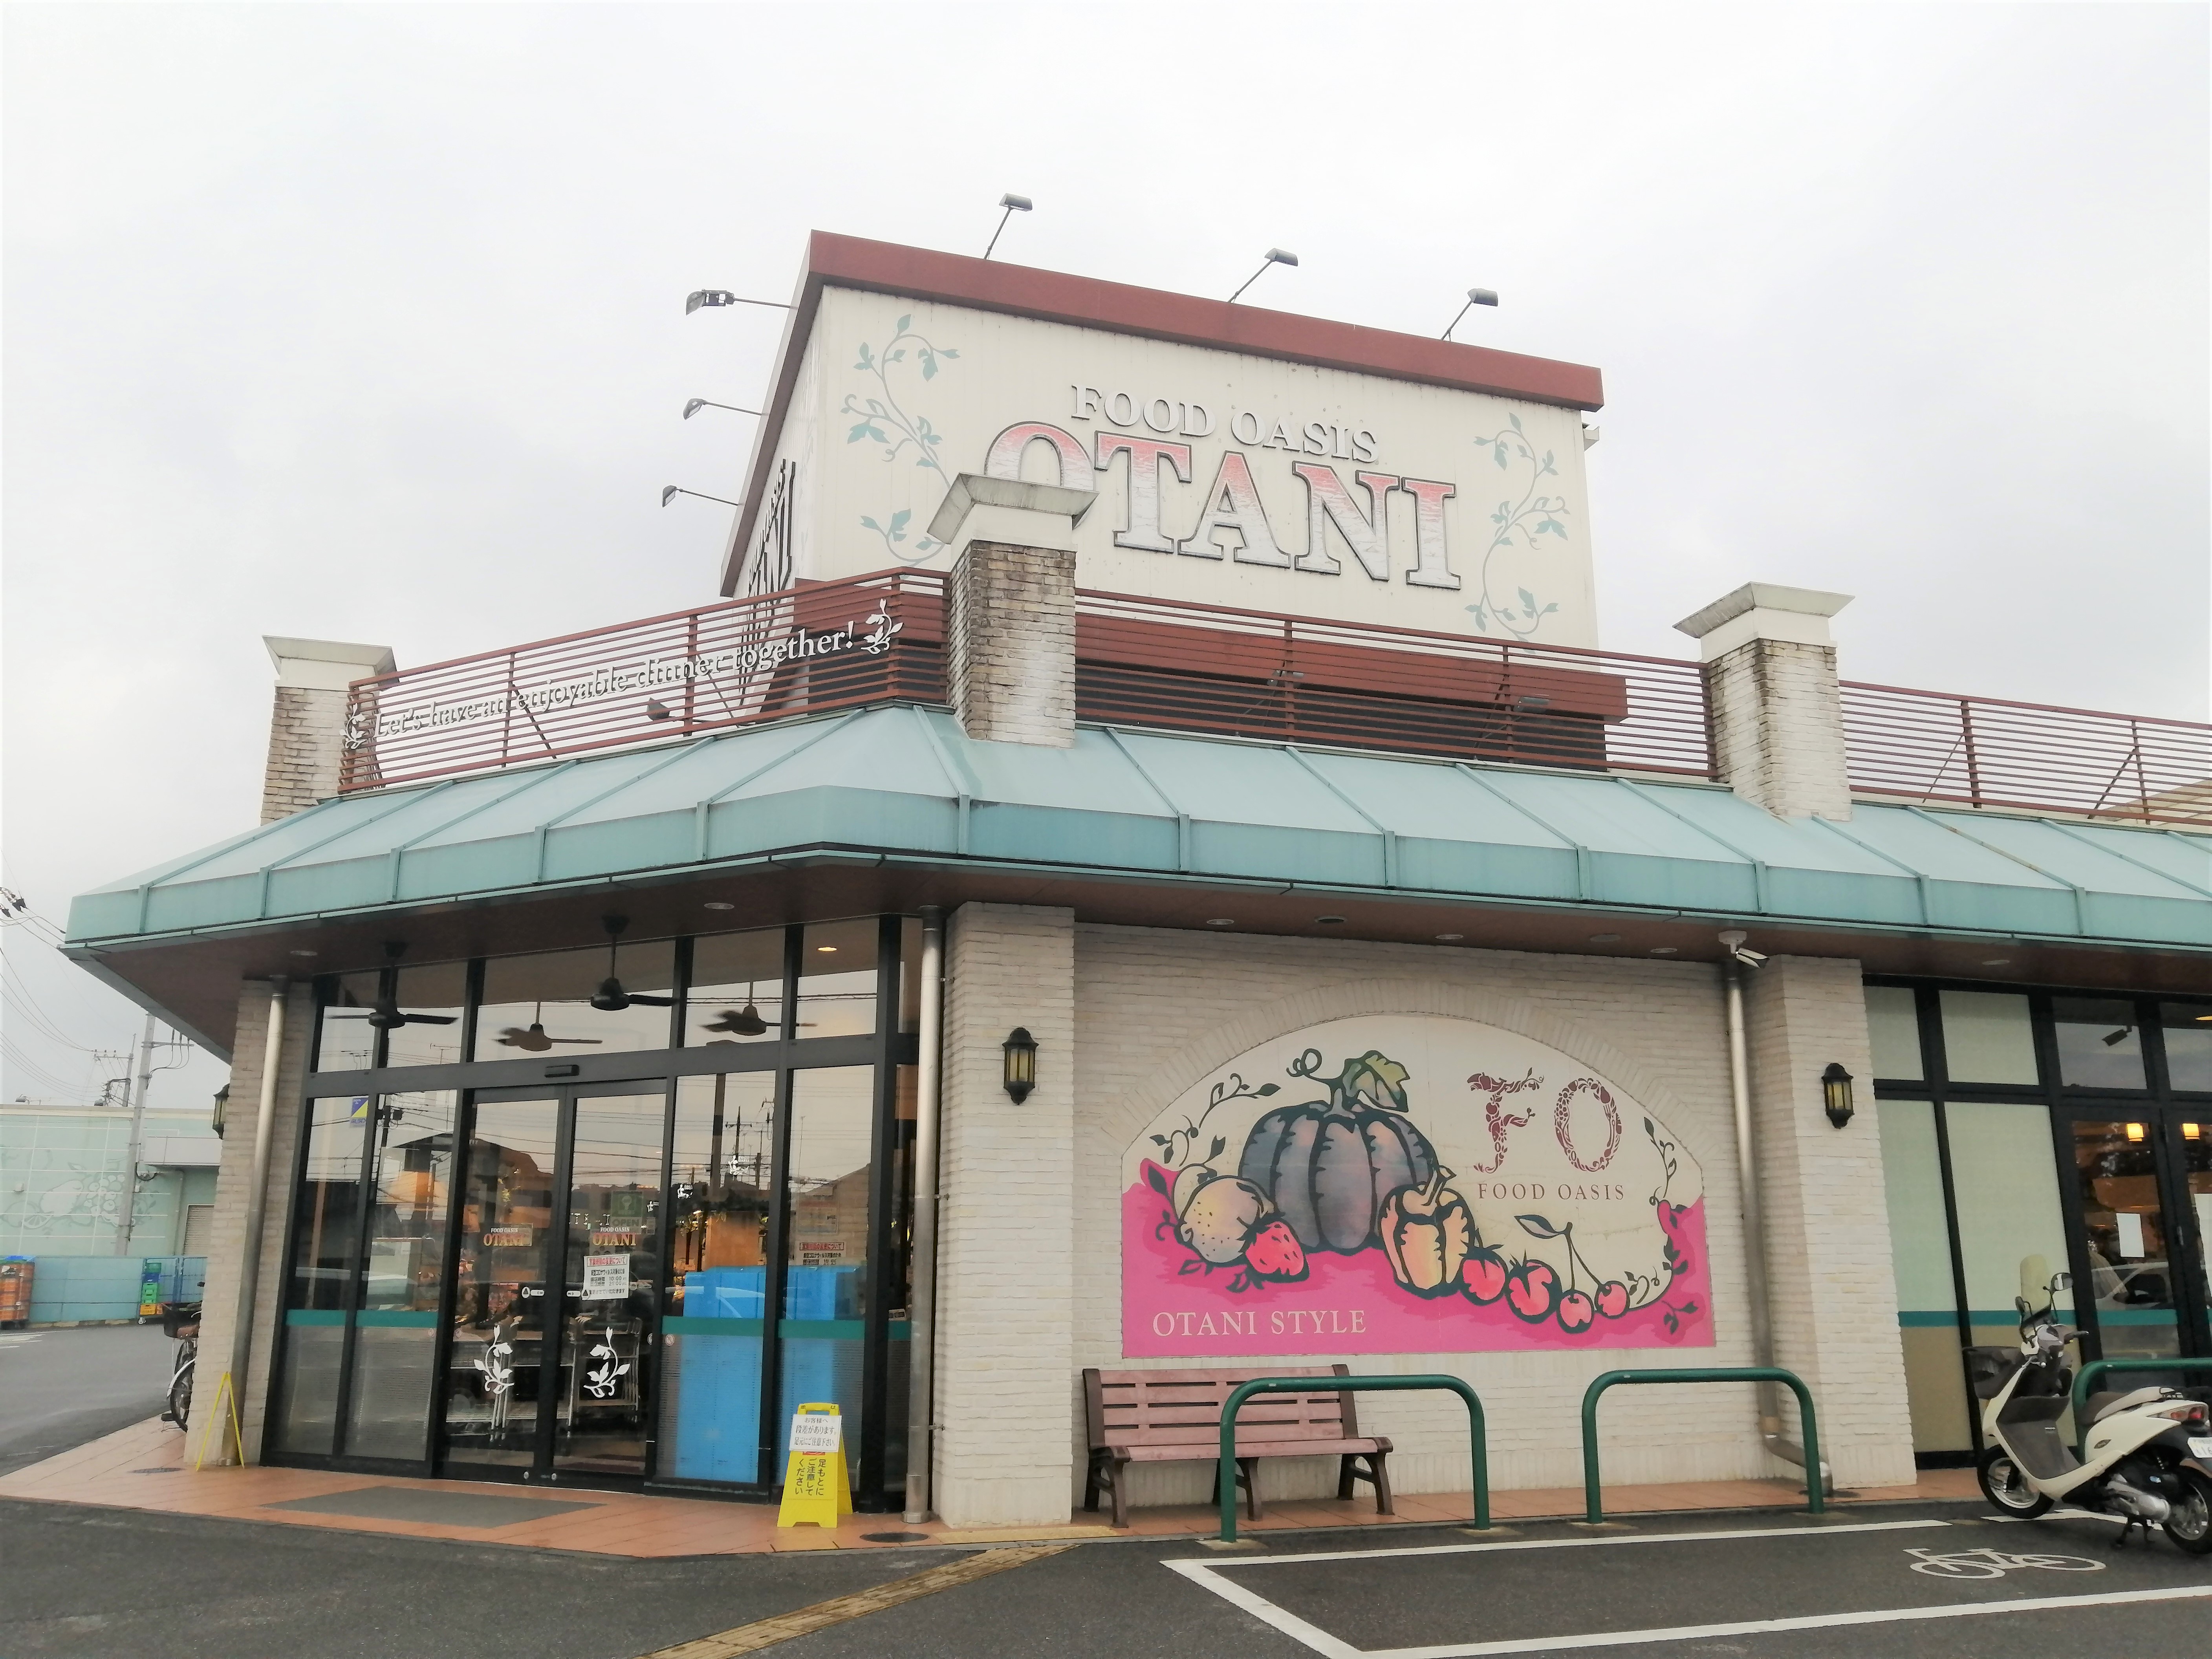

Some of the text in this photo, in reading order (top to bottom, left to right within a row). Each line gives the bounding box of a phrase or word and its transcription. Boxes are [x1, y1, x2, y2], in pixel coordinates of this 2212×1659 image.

[1071, 385, 1379, 463] FOOD OASIS
[983, 420, 1462, 590] OTANI
[373, 619, 855, 738] Let's have an enjoyable dinner together!
[1478, 1182, 1625, 1200] FOOD OASIS
[592, 1232, 636, 1246] OTANI
[1153, 1310, 1366, 1337] OTANI STYLE
[795, 1458, 805, 1494] ください
[816, 1459, 826, 1496] 足もとに
